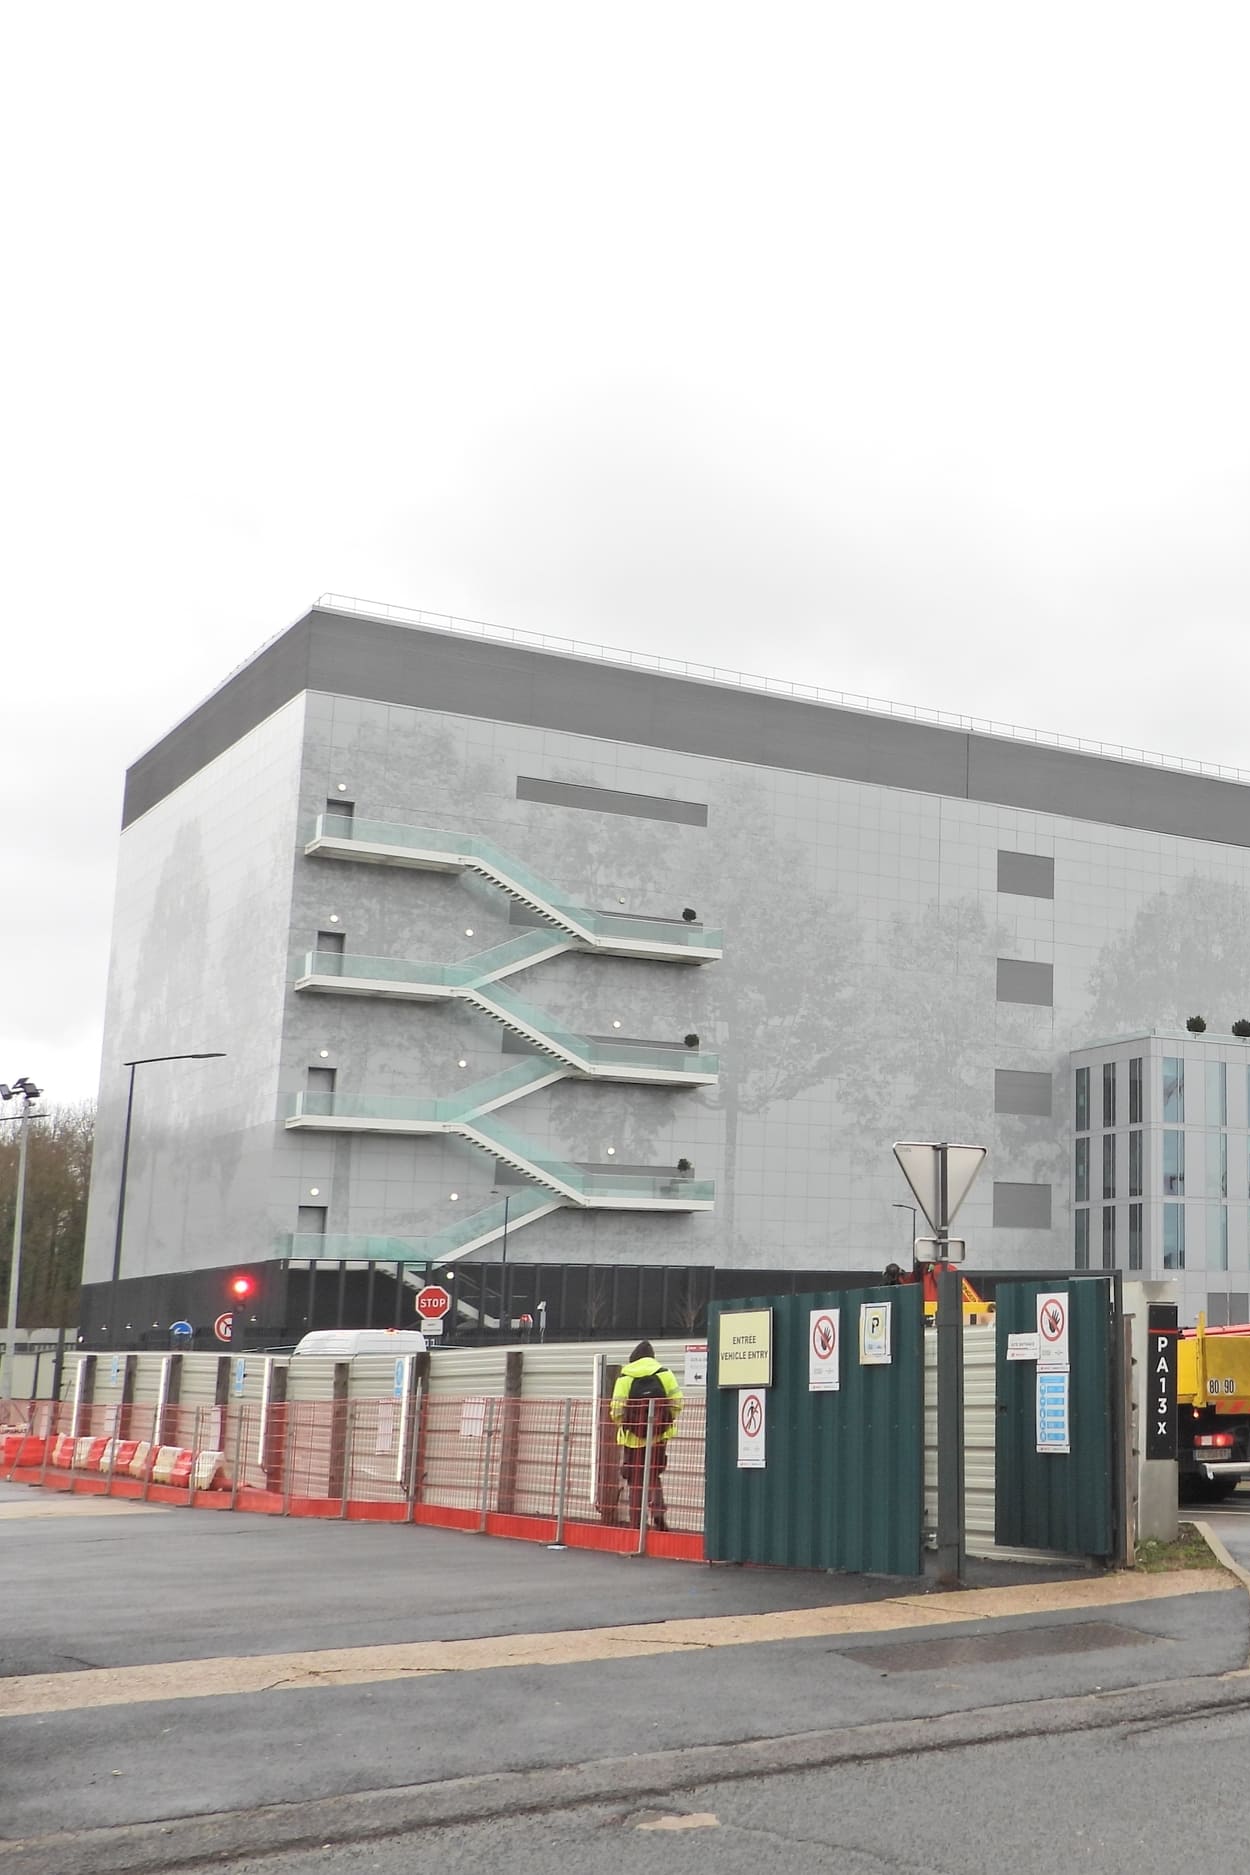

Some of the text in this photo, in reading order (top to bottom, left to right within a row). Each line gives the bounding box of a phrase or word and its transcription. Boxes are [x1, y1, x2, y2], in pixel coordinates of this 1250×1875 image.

[420, 1298, 446, 1308] STOP
[721, 1350, 768, 1360] VEHICLE ENTRY
[1209, 1379, 1220, 1393] 80
[1224, 1379, 1235, 1393] 90
